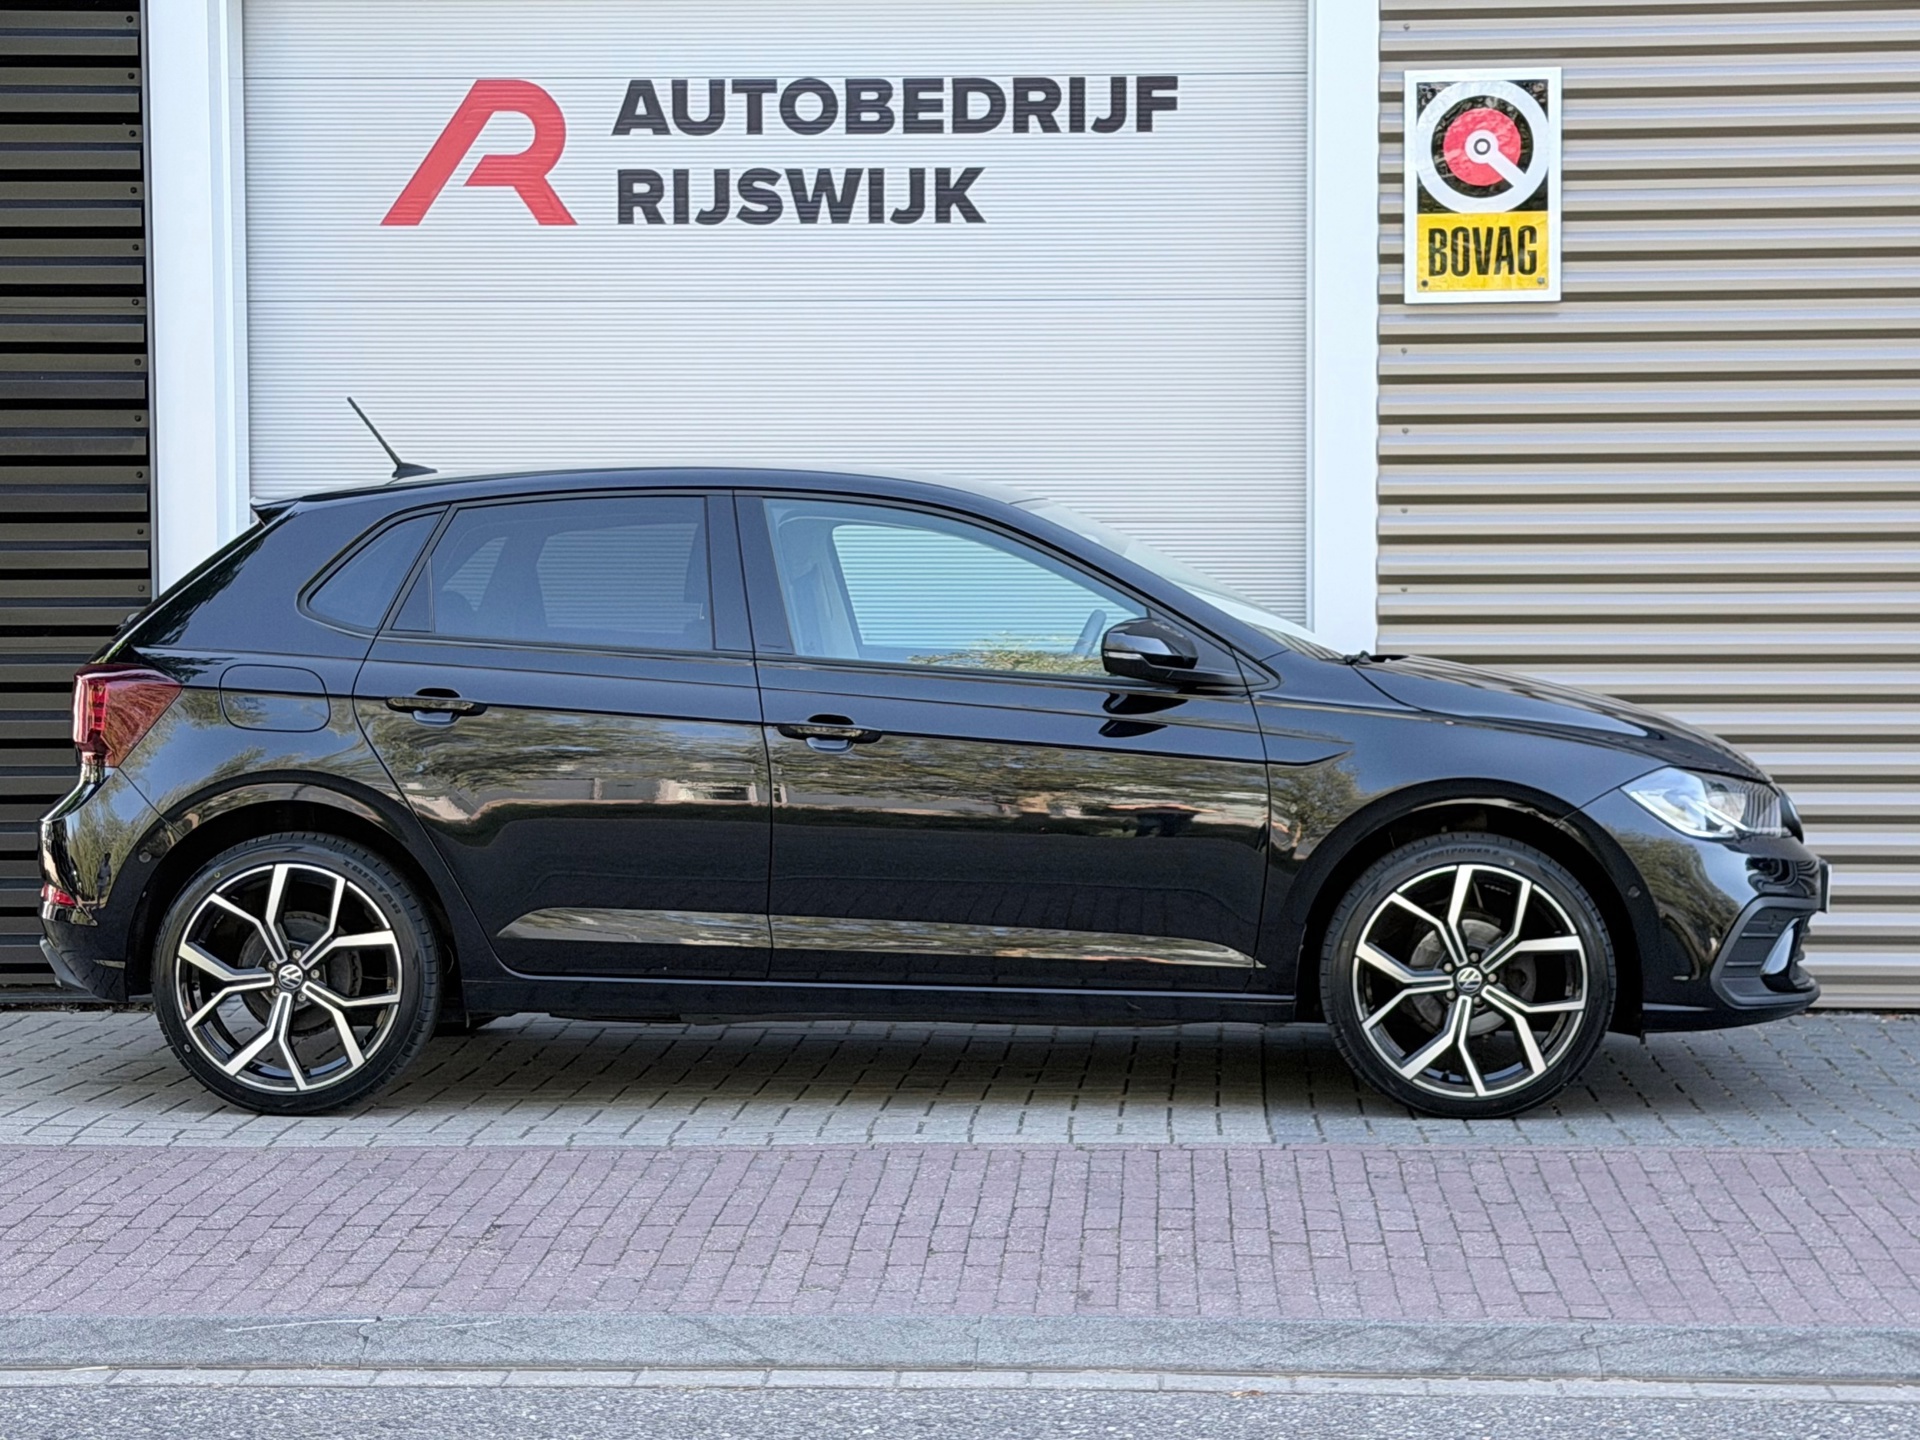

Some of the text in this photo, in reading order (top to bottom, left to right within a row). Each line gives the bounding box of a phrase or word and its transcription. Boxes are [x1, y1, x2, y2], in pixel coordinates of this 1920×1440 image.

[612, 75, 1178, 135] AUTOBEDRIJF
[618, 167, 985, 225] RIJSWIJK
[1429, 225, 1537, 277] BOVAG
